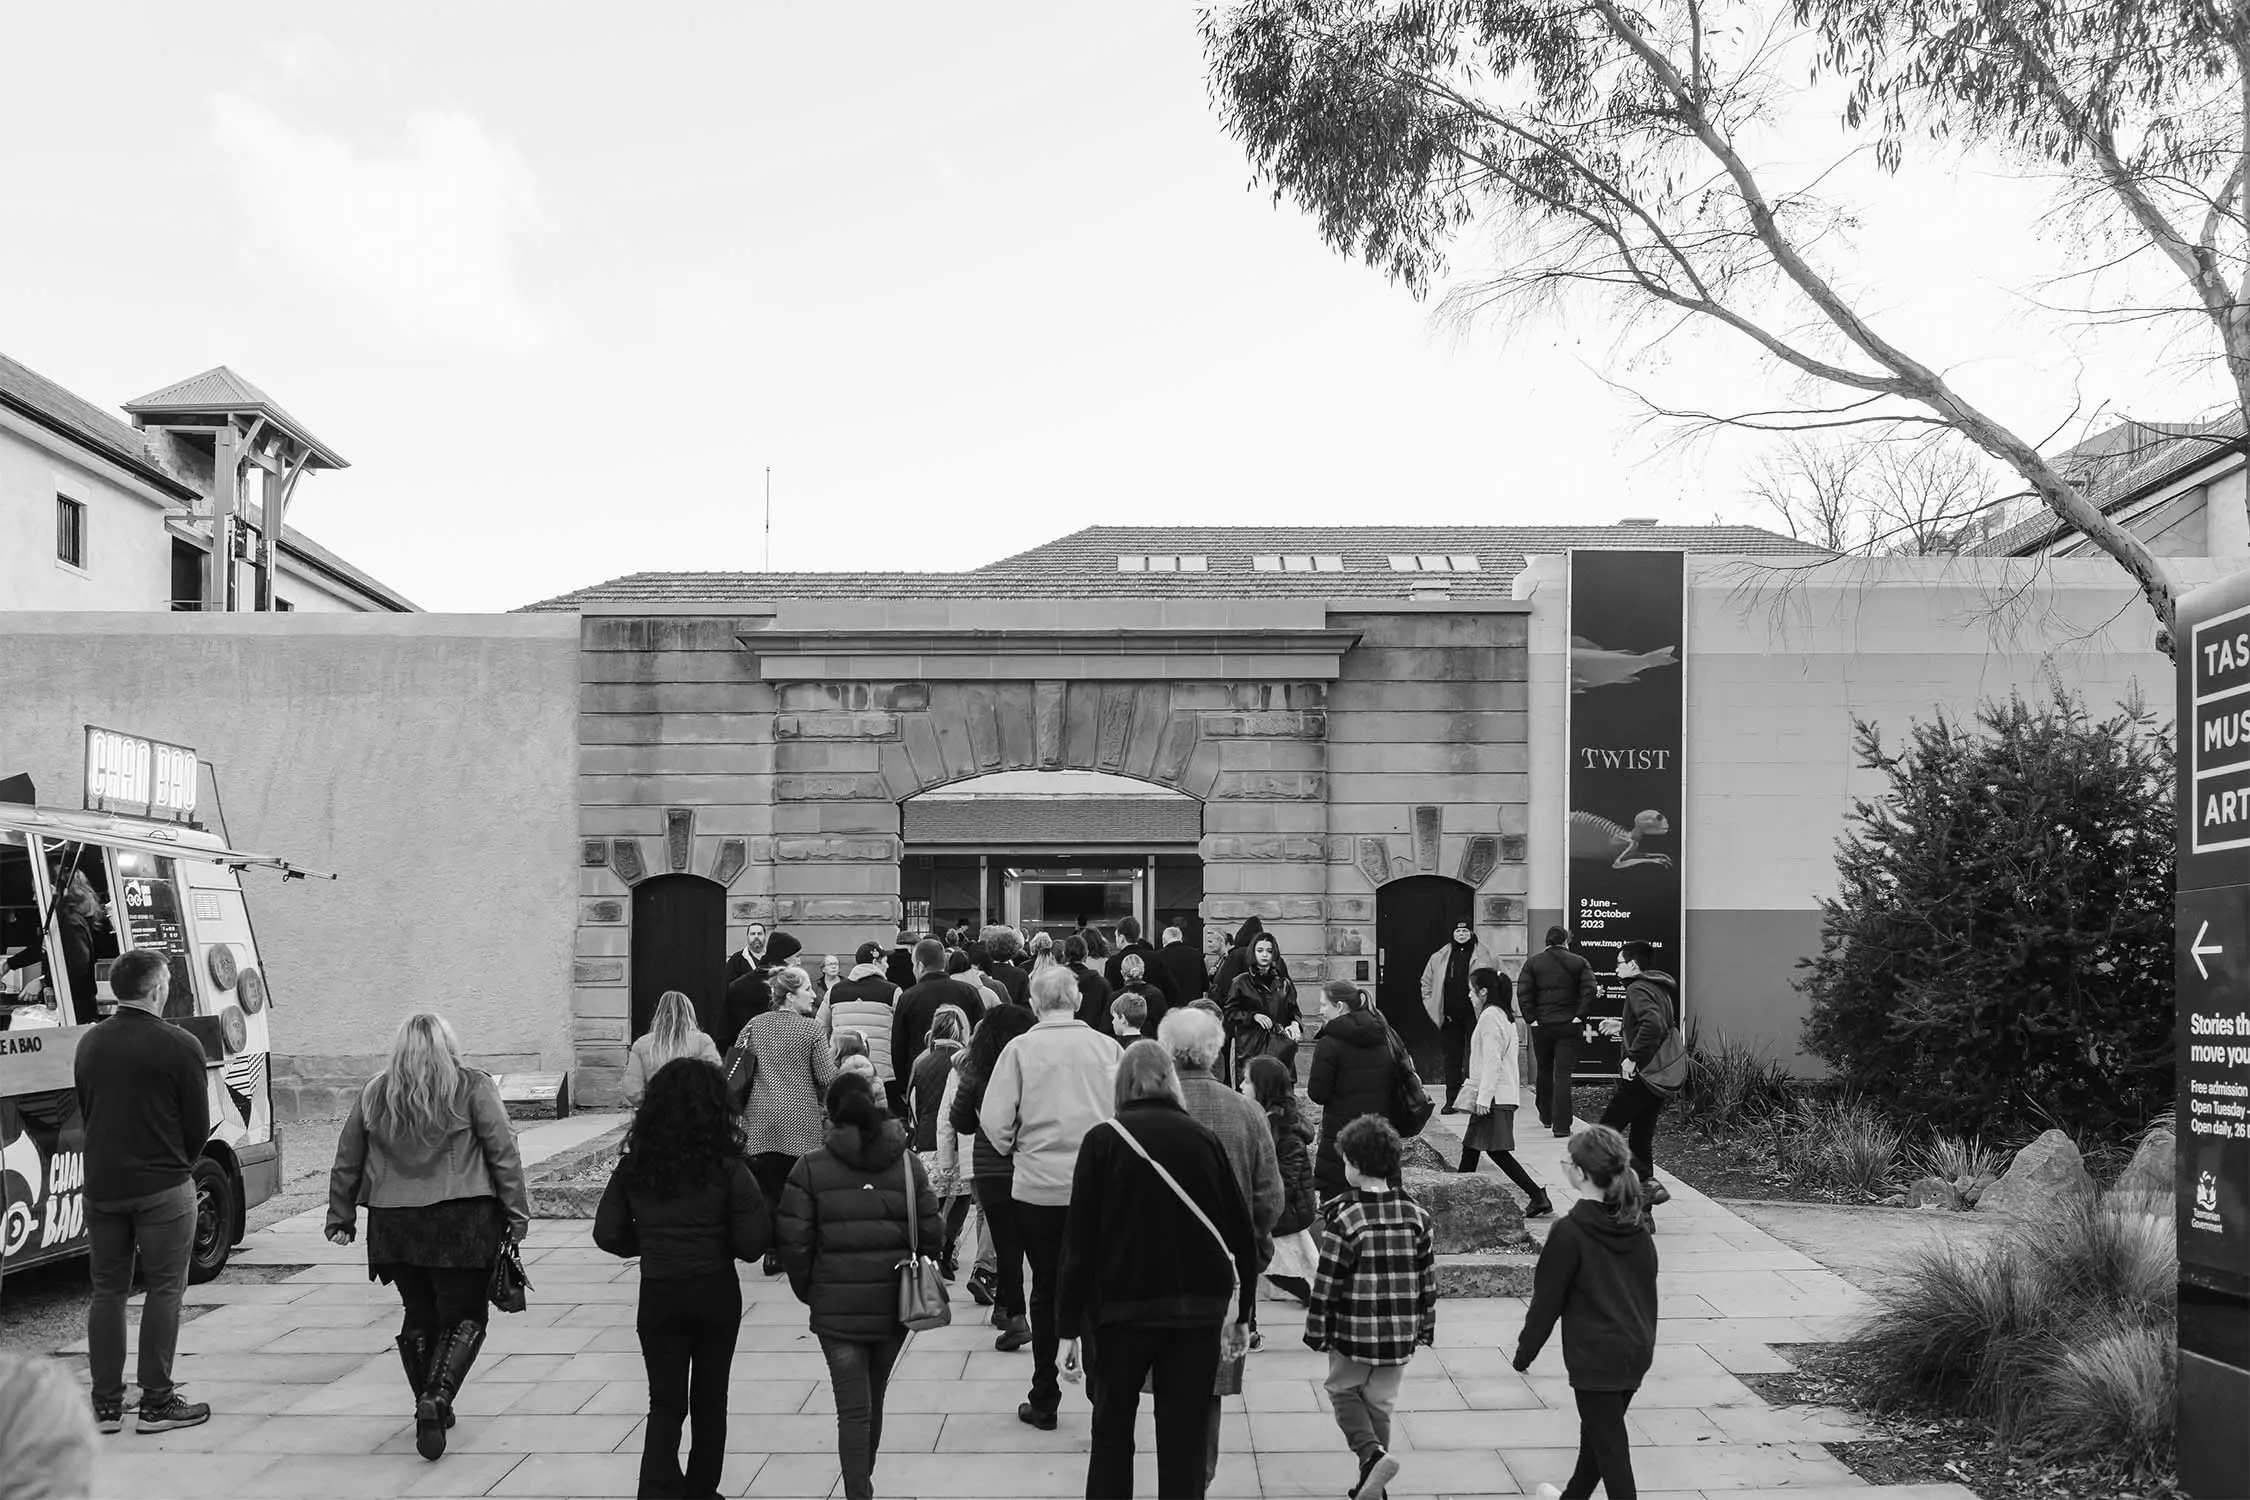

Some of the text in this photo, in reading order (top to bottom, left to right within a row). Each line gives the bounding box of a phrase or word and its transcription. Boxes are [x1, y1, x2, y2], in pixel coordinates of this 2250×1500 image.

[2204, 634, 2250, 677] TAS
[2204, 709, 2250, 752] MUS
[1581, 747, 1670, 770] TWIST
[89, 730, 197, 812] CHAN BAO
[2204, 787, 2250, 827] ART
[1580, 898, 1588, 907] 9
[1589, 898, 1611, 907] June
[1580, 909, 1631, 918] 22 October
[1580, 920, 1605, 929] 2023
[2191, 1012, 2235, 1035] Stories
[9, 1039, 18, 1054] A
[18, 1036, 42, 1053] BAO
[2191, 1045, 2250, 1068] move you
[2191, 1079, 2249, 1097] Free admission
[2191, 1098, 2212, 1116] Open
[2212, 1100, 2246, 1121] Tuesday
[2191, 1118, 2246, 1139] Open daily, 26
[41, 1193, 84, 1249] BAO
[2191, 1217, 2223, 1234] Government
